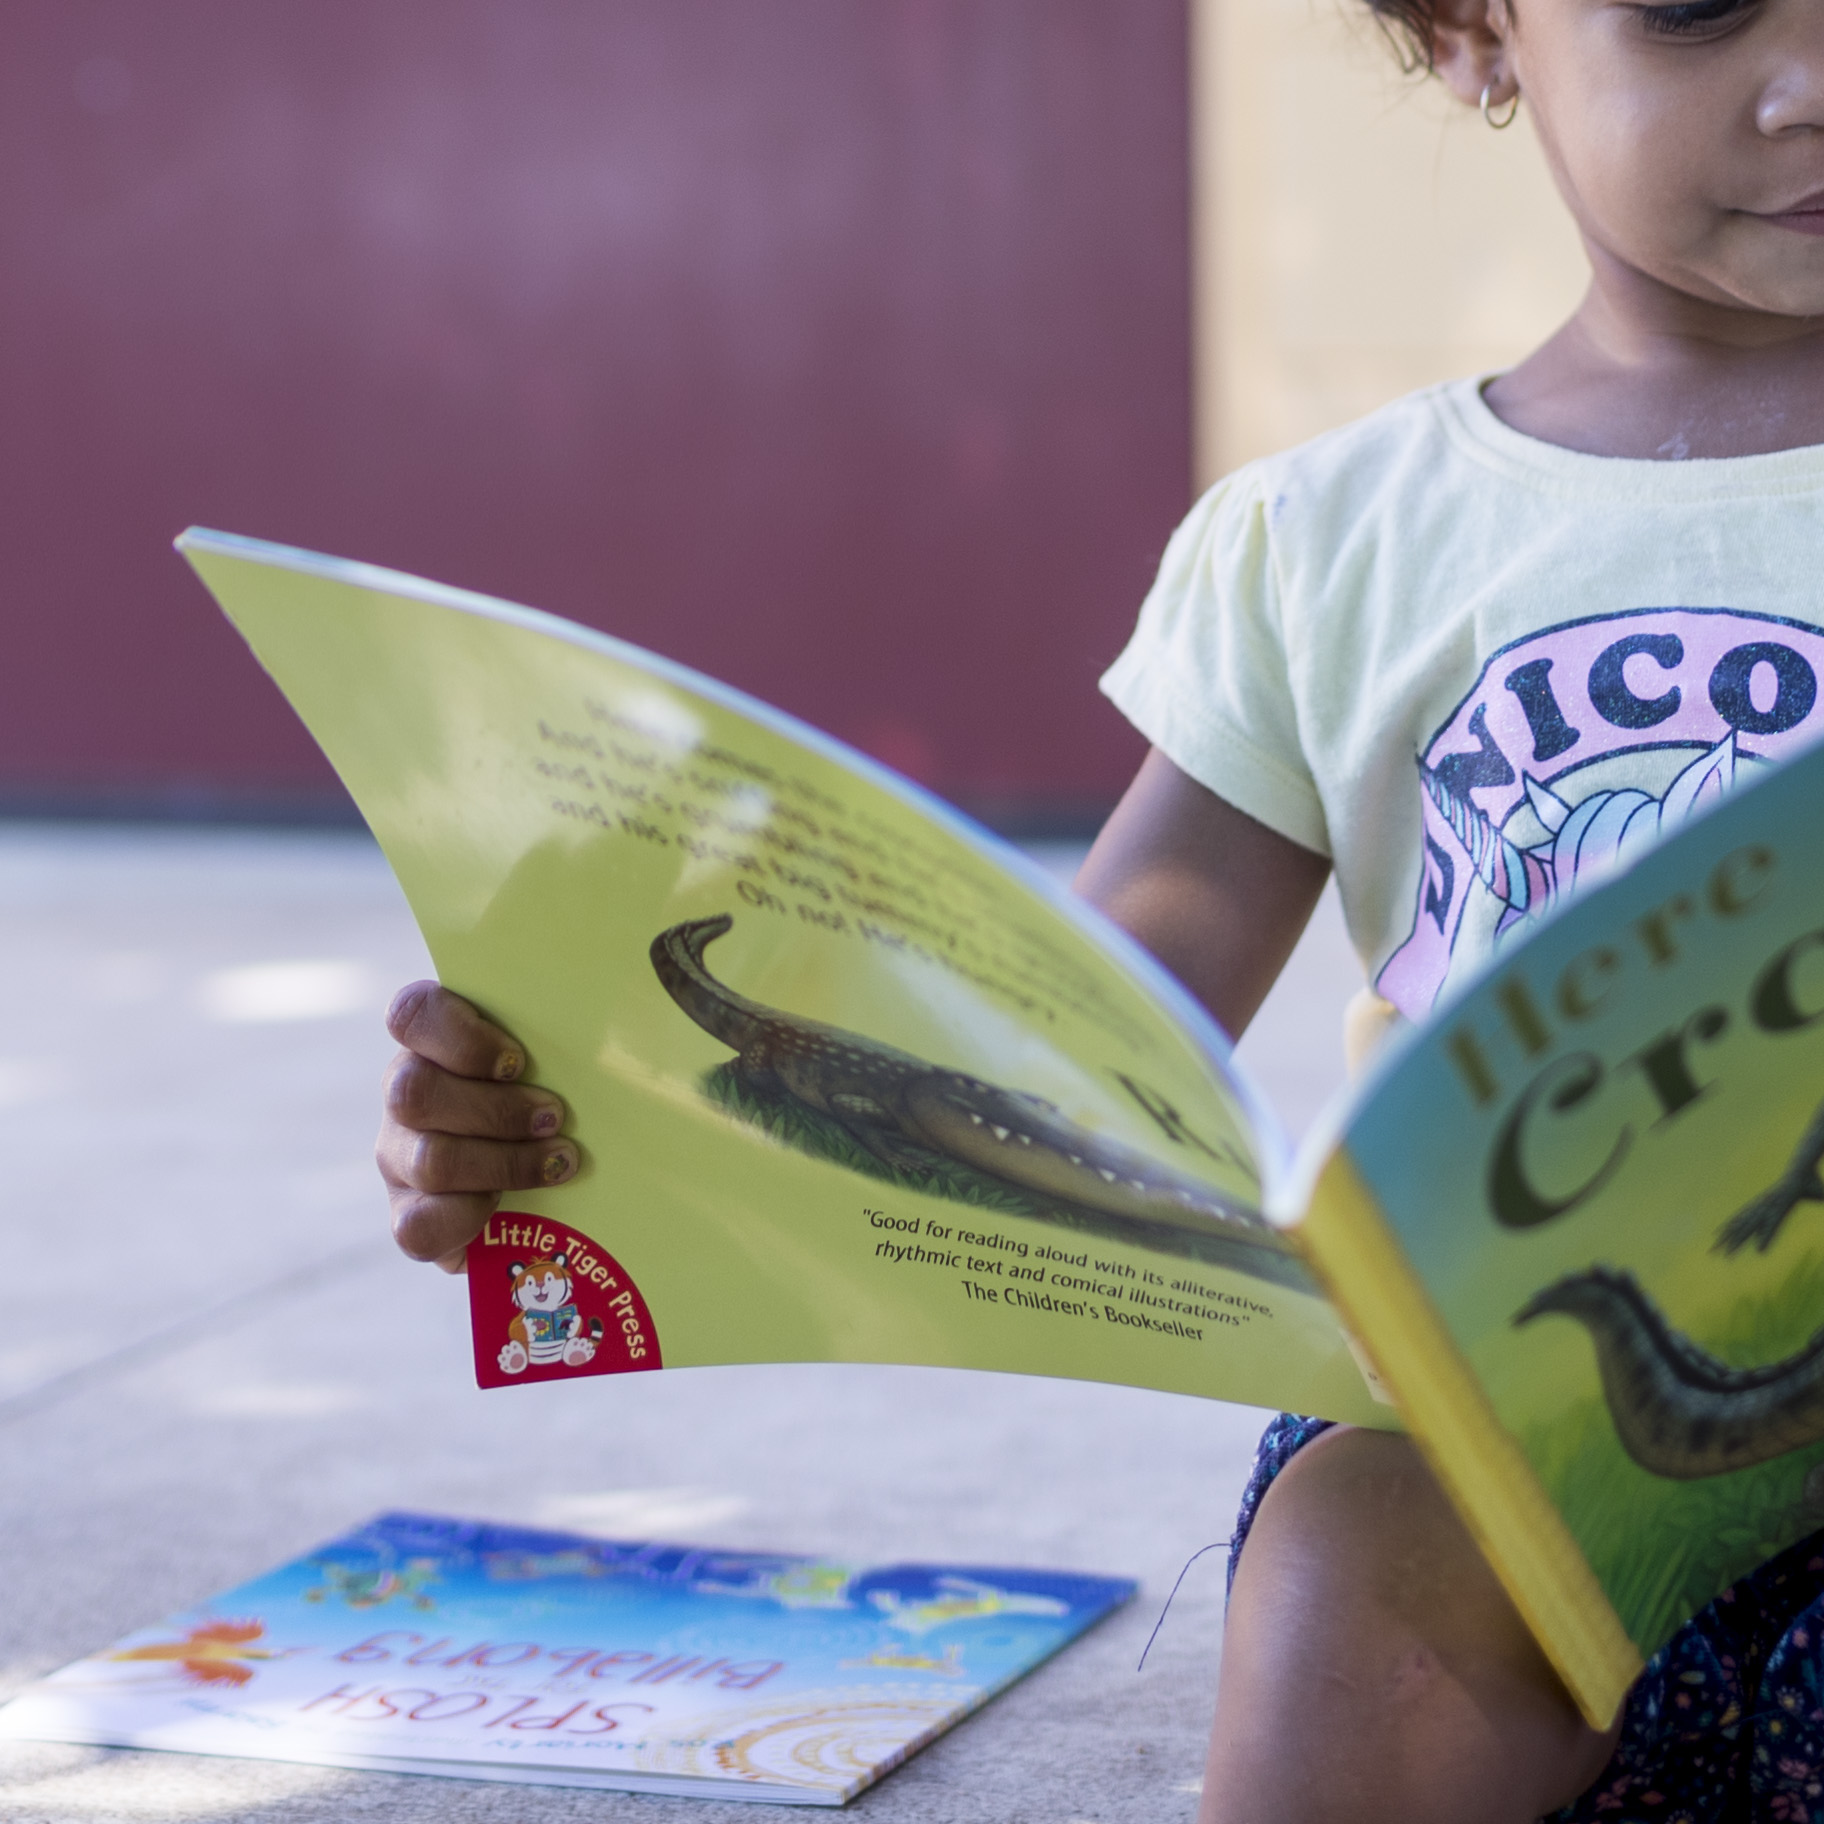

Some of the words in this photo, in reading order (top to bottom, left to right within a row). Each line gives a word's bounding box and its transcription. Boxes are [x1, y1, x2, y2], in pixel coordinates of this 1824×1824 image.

[1446, 838, 1776, 1112] Here
[484, 1220, 557, 1253] Little
[564, 1236, 619, 1291] Tiger
[608, 1289, 647, 1360] Press
[863, 1208, 921, 1234] "Good
[925, 1219, 954, 1240] for
[957, 1229, 1029, 1258] reading
[1034, 1245, 1088, 1268] aloud
[1094, 1258, 1137, 1279] with
[1142, 1268, 1165, 1287] its
[1170, 1278, 1275, 1319] alliterative,
[874, 1239, 962, 1268] rhythmic
[966, 1254, 1004, 1277] text
[1008, 1264, 1046, 1284] and
[1050, 1272, 1124, 1300] comical
[1128, 1287, 1251, 1327] illustrations"
[961, 1279, 999, 1304] The
[1004, 1286, 1100, 1320] Children's
[1103, 1304, 1205, 1341] Bookseller
[332, 1629, 786, 1690] Billabong
[298, 1683, 657, 1735] SPLOSH
